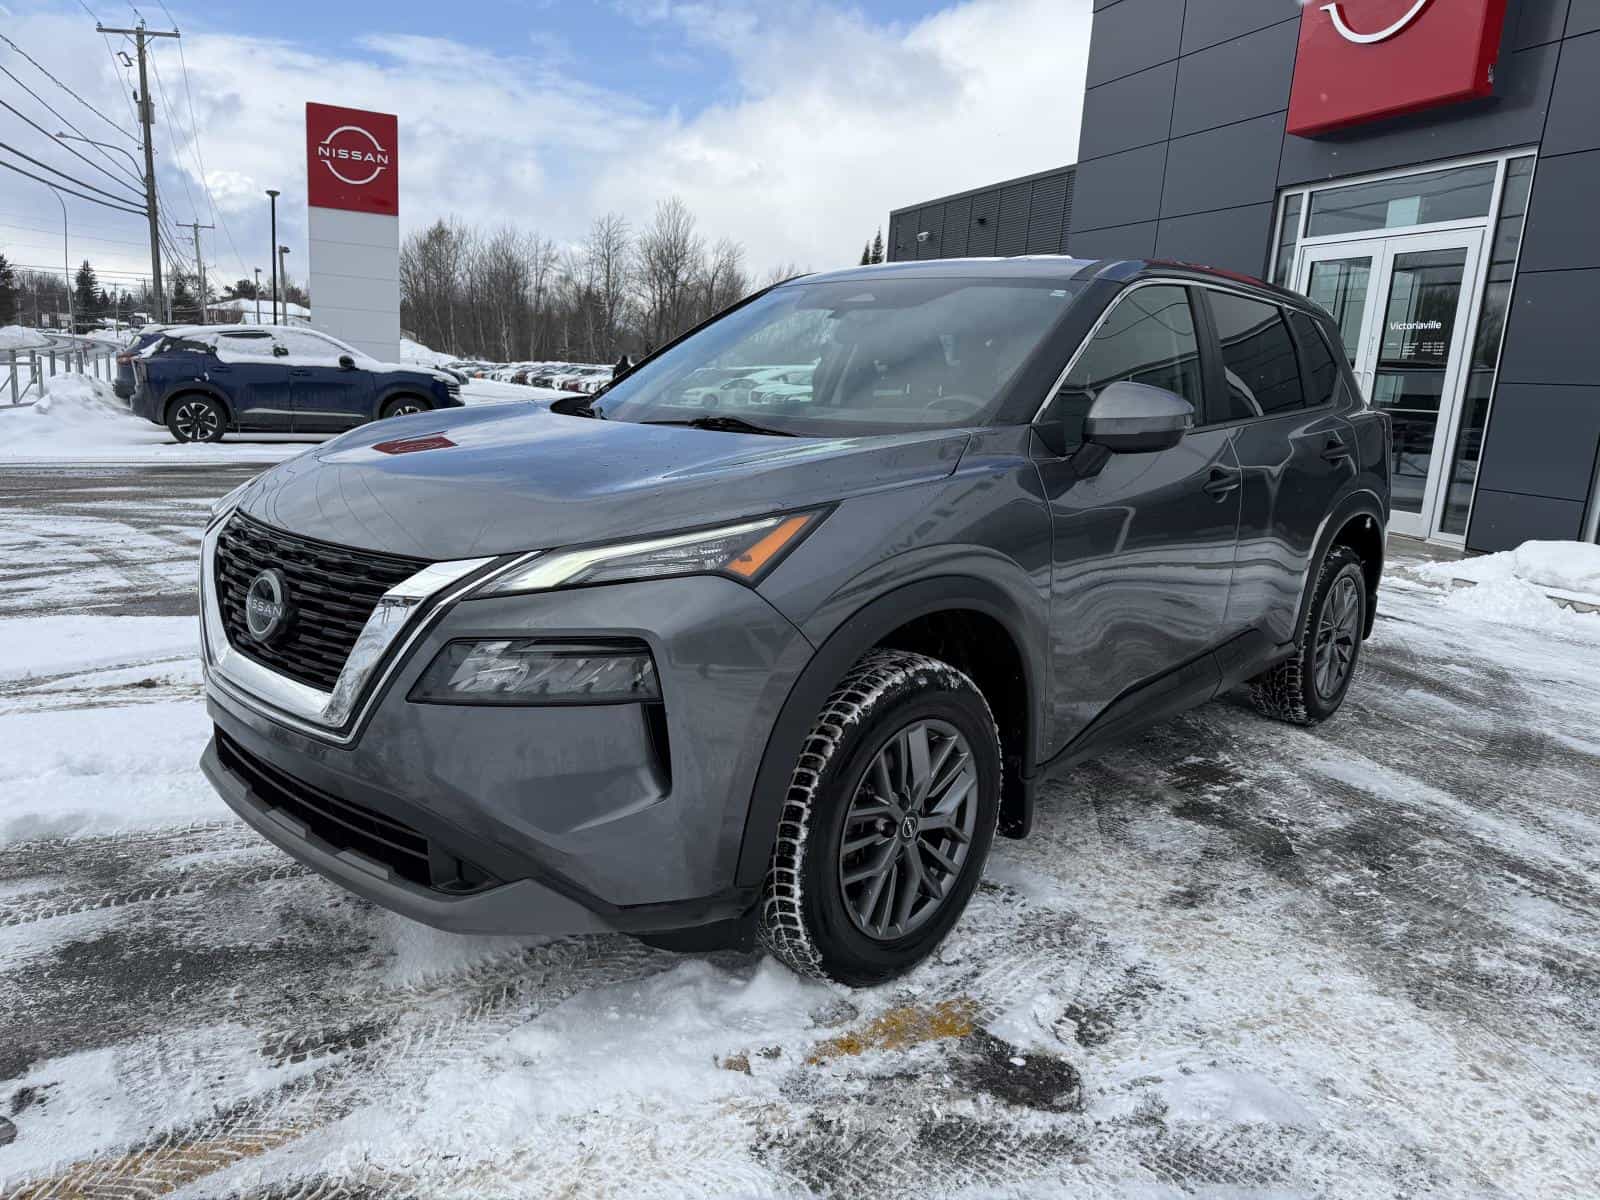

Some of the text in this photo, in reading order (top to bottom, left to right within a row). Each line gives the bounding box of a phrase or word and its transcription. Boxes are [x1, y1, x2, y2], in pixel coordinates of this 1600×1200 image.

[318, 146, 389, 164] NISSAN
[1390, 320, 1442, 330] Victoriaville
[247, 597, 282, 617] SSAN
